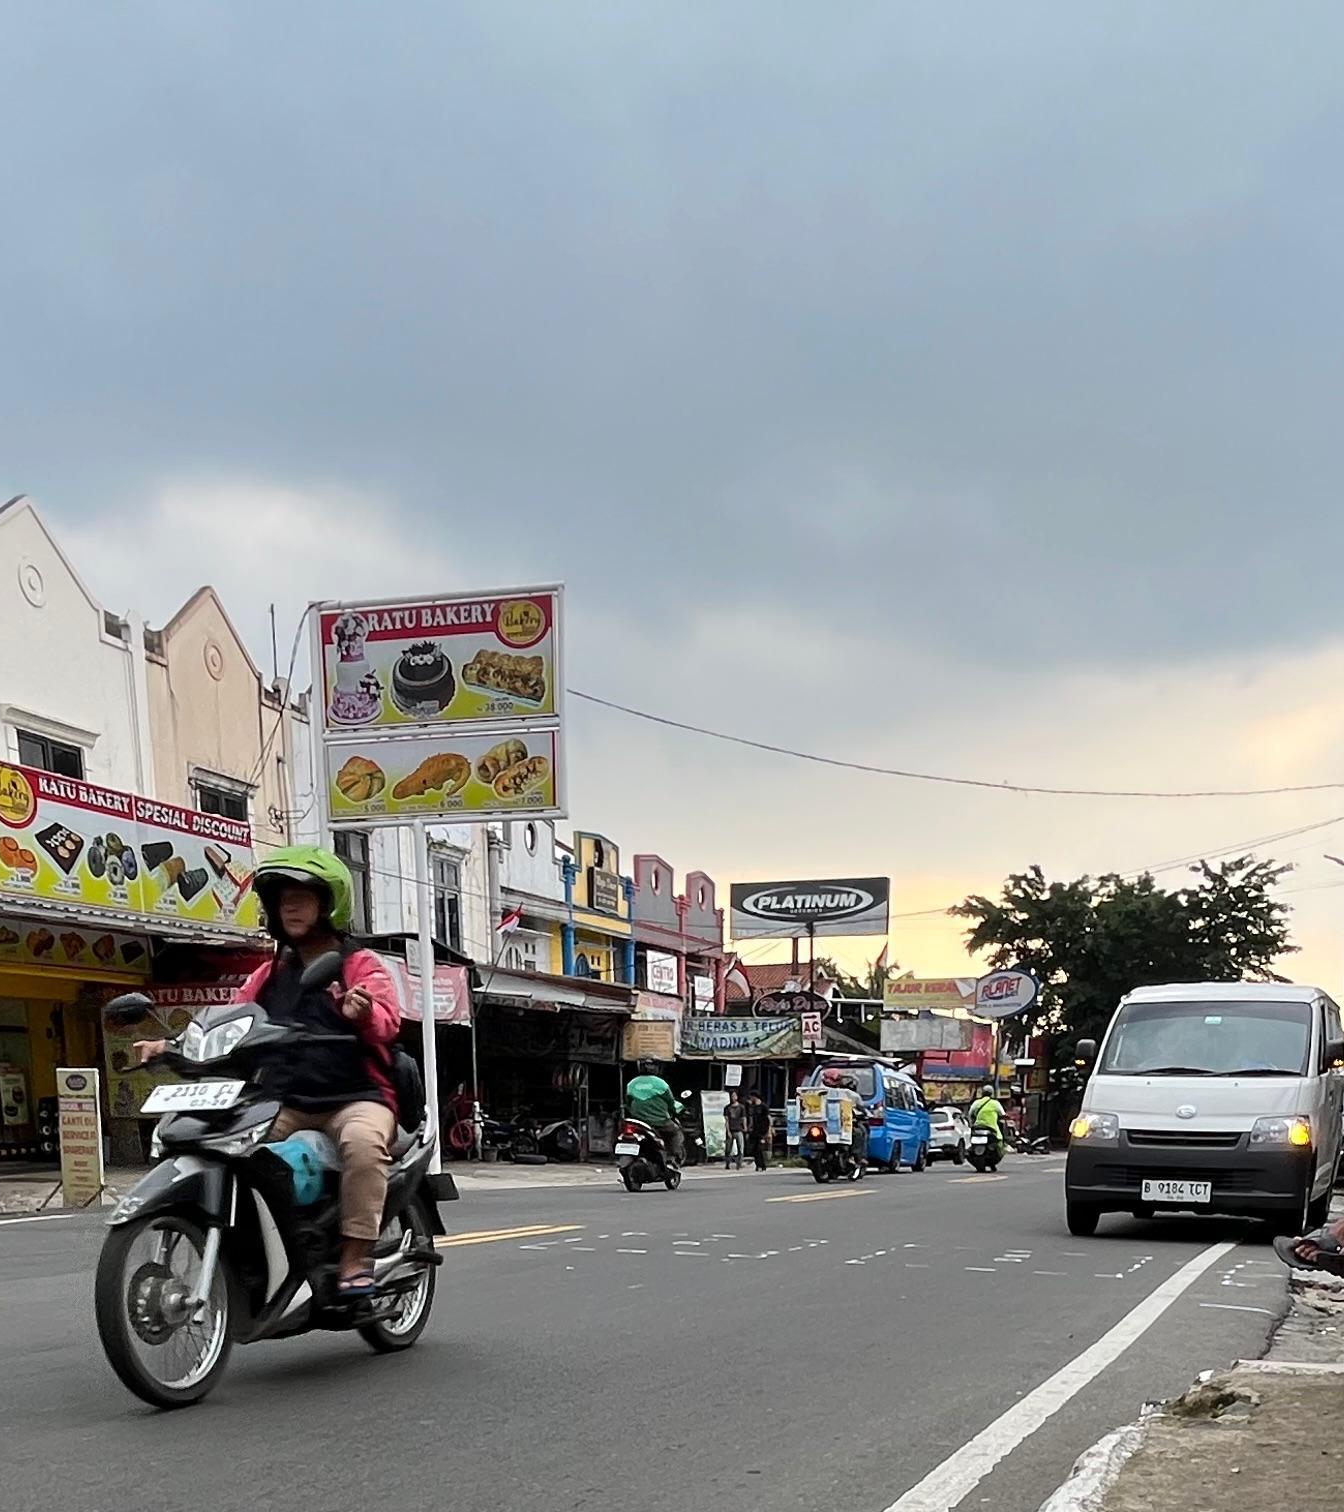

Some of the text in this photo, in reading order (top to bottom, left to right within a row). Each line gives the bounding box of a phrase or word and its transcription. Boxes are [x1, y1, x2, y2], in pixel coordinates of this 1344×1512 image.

[368, 603, 496, 632] RATU BAKERY
[79, 785, 130, 813] BAKERY
[136, 800, 189, 829] SPESIAL
[193, 816, 251, 844] DISCOUNT
[758, 893, 856, 910] PLATINUM
[981, 976, 1023, 999] PLANET
[699, 1020, 737, 1032] BERAS
[804, 1021, 820, 1033] AC
[700, 1036, 750, 1049] MADINA
[1144, 1182, 1151, 1193] B
